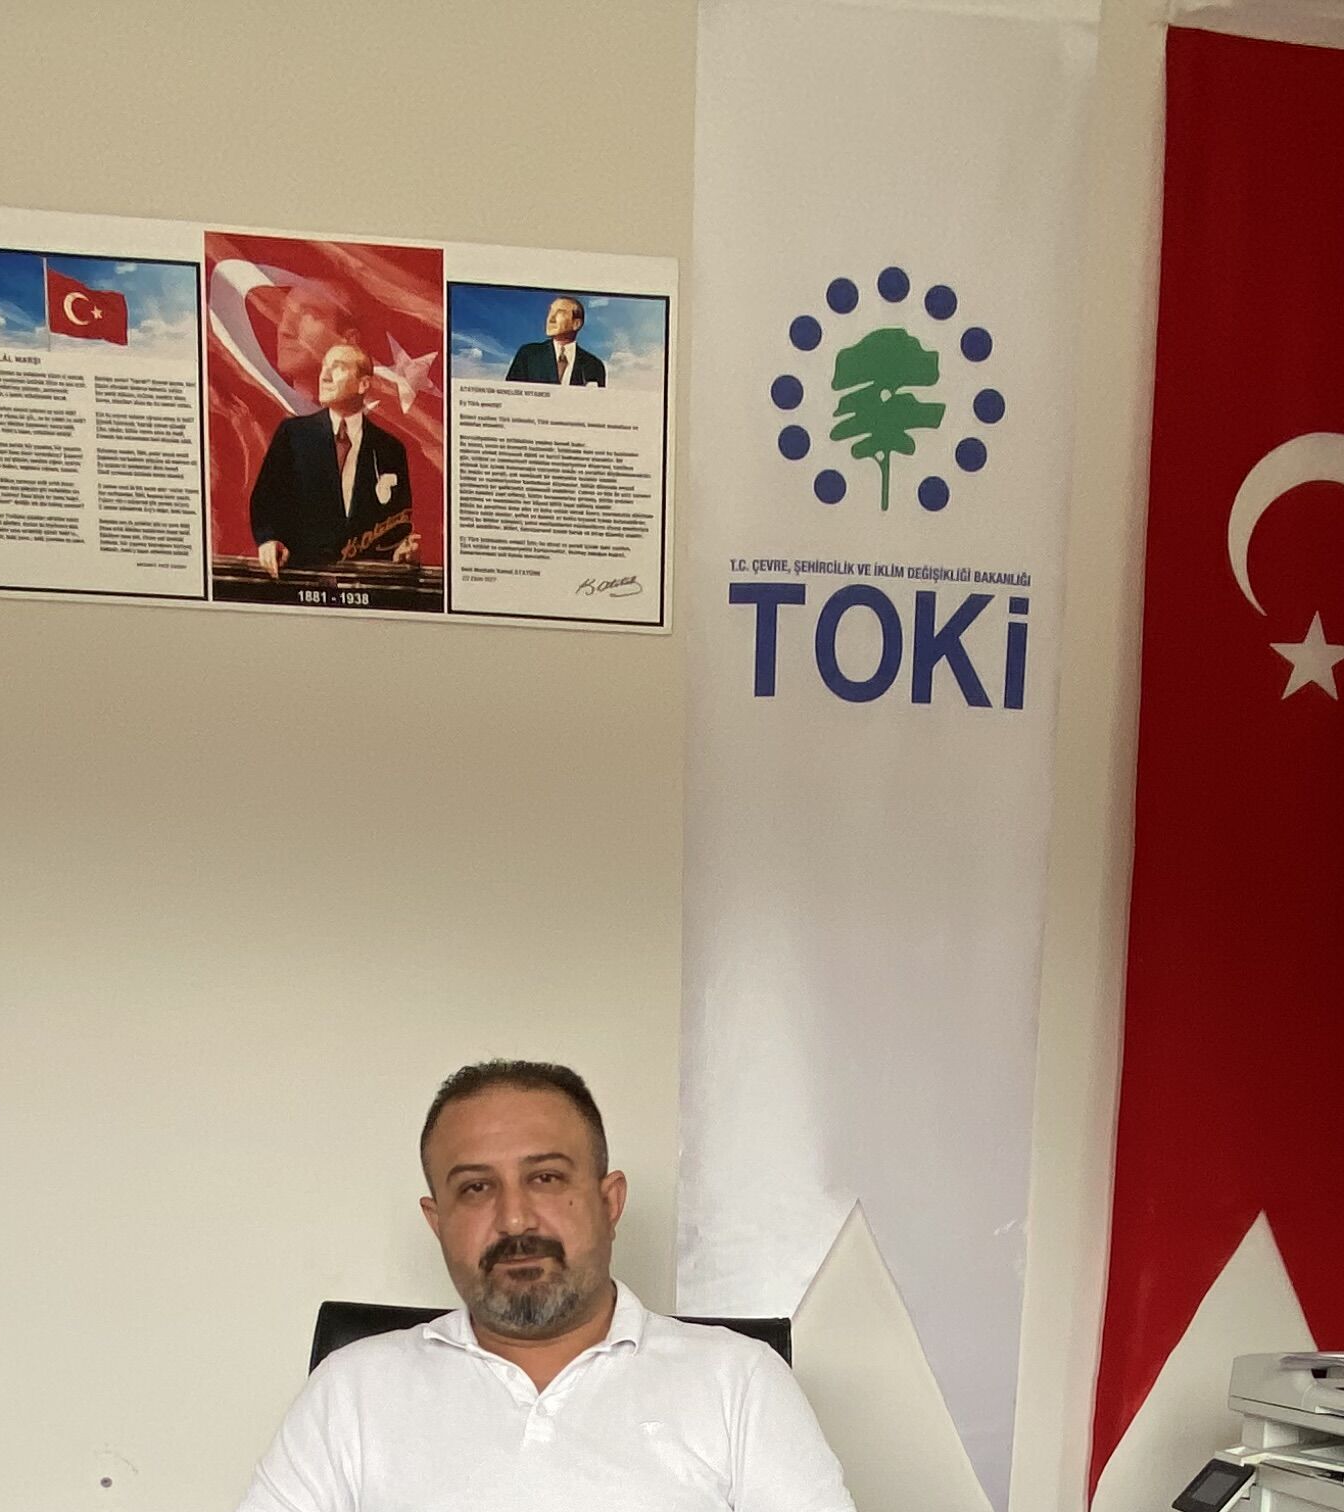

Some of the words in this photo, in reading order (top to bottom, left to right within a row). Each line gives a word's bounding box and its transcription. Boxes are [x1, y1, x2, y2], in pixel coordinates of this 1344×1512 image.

[730, 559, 749, 572] T.C.
[752, 559, 791, 574] ÇEVRE,
[794, 560, 855, 576] ŞEHİRCİLİK
[857, 563, 871, 576] VE
[874, 562, 904, 578] İKLİM
[907, 564, 971, 583] DEĞİŞİKLİĞİ
[974, 569, 1031, 587] BAKANLIĞI
[298, 590, 327, 602] 1881
[340, 591, 369, 605] 1938
